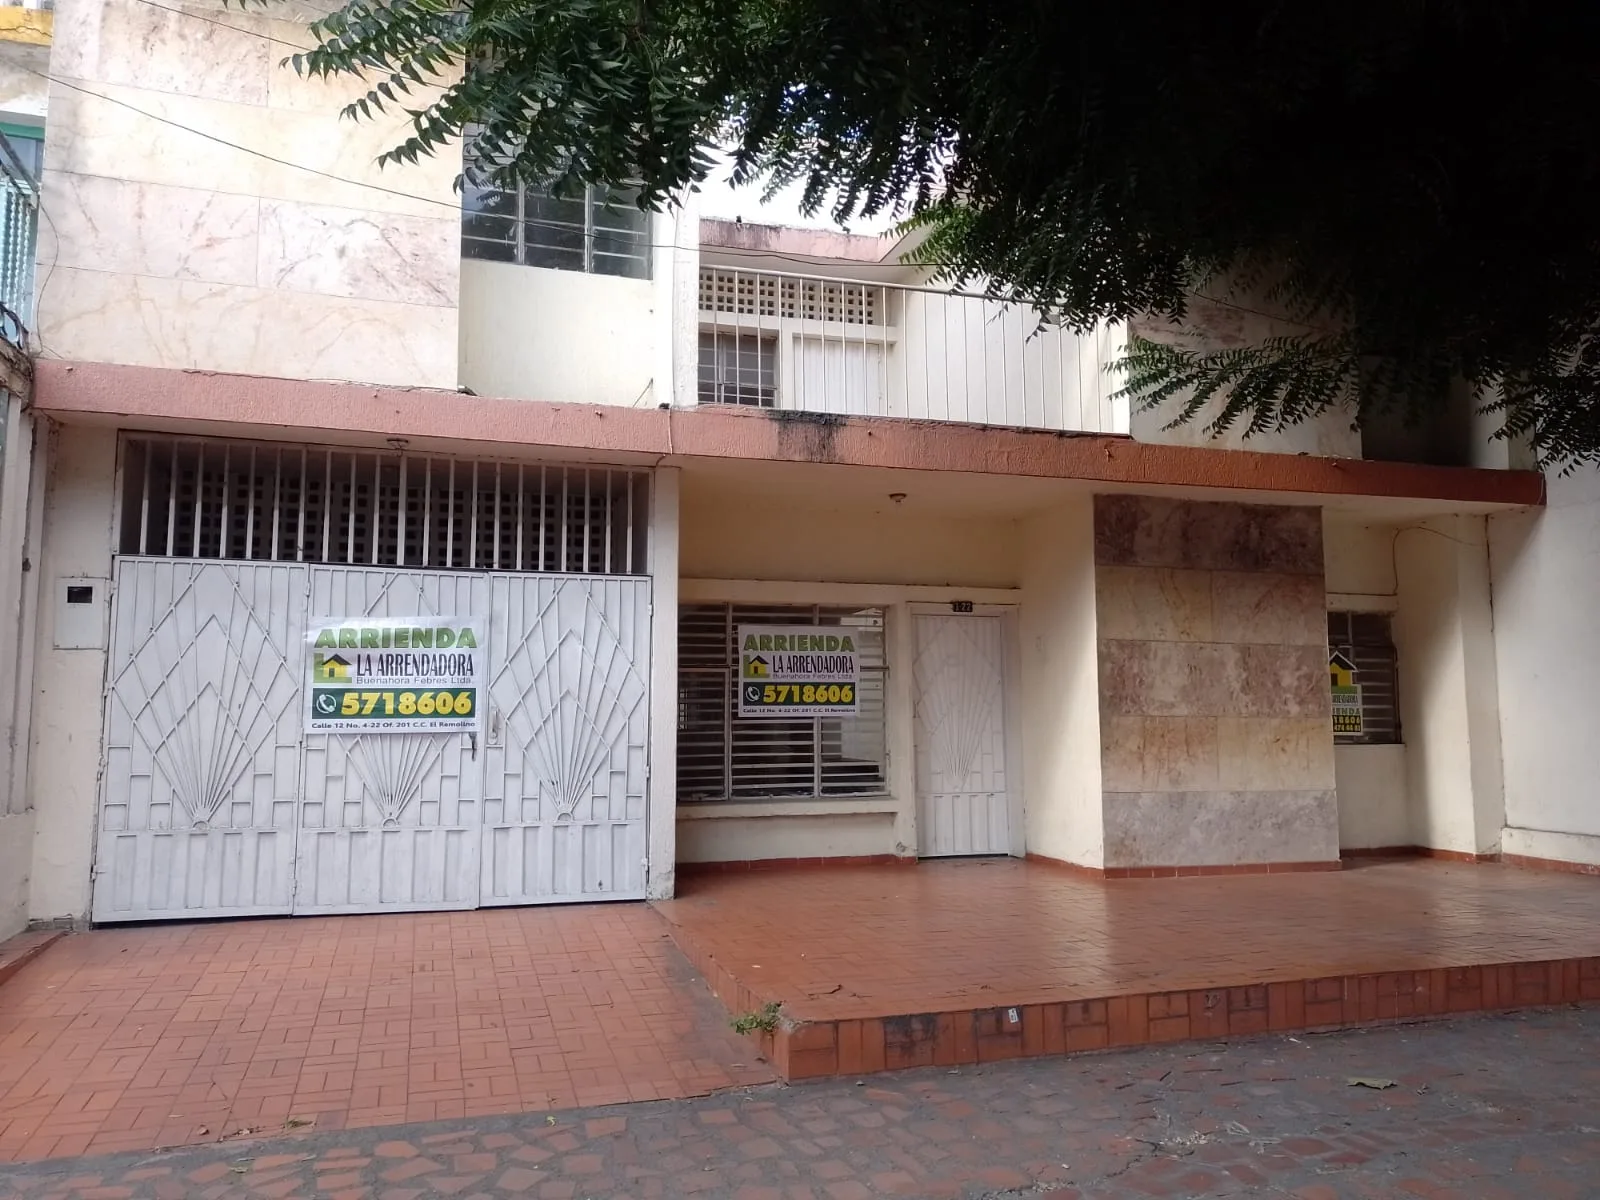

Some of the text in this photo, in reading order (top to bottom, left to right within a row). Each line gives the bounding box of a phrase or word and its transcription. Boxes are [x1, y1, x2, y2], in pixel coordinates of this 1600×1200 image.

[314, 628, 477, 648] ARRIENDA
[743, 634, 855, 652] ARRIENDA
[357, 653, 473, 676] LA ARRENDADORA
[772, 655, 854, 673] LA ARRENDADORA
[341, 692, 472, 715] 5718606
[763, 685, 853, 703] 5718606
